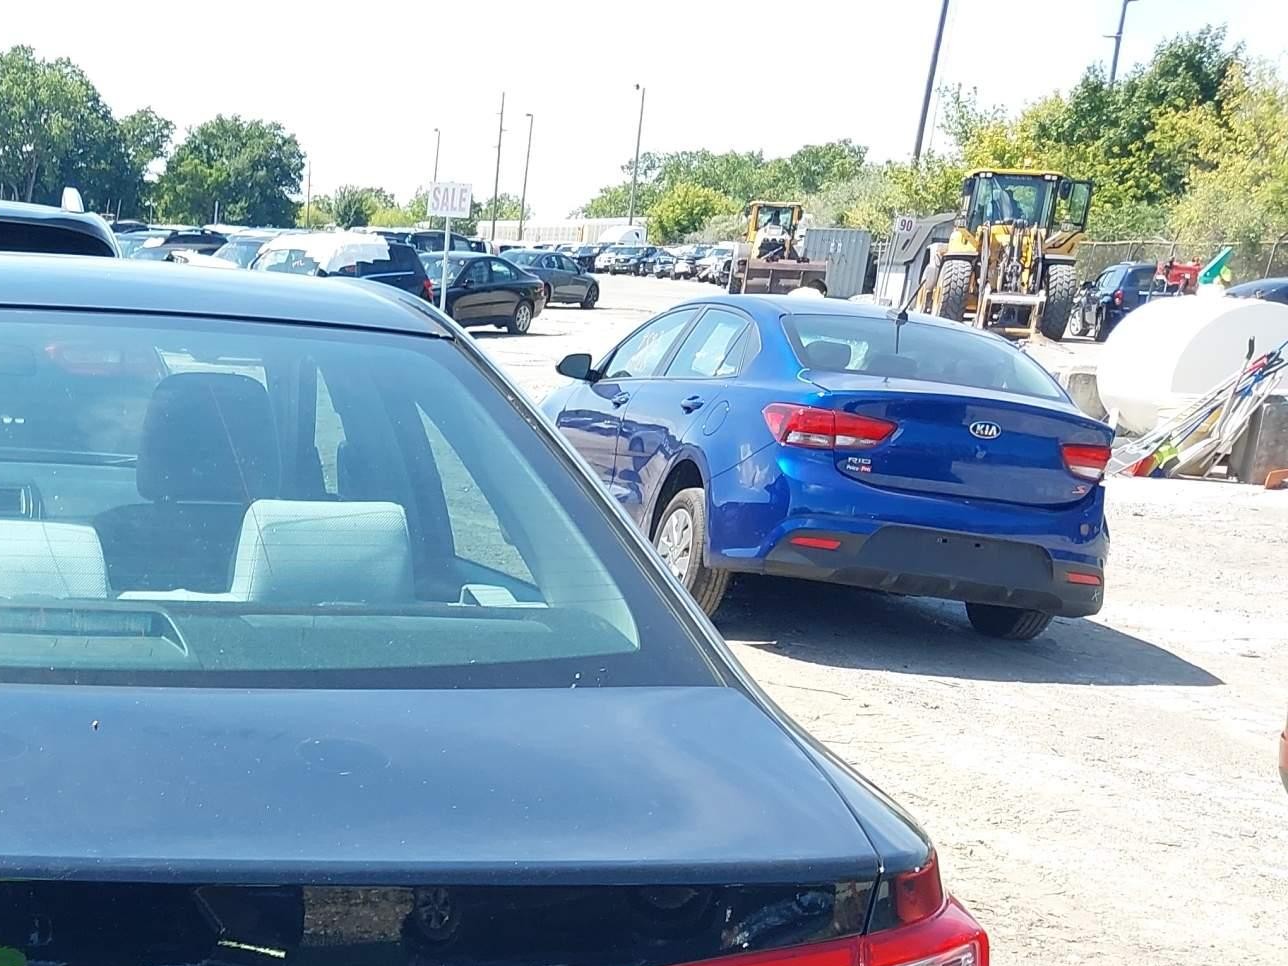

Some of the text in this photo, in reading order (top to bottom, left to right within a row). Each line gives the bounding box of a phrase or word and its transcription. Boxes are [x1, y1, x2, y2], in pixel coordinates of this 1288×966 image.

[432, 186, 468, 212] SALE
[900, 219, 913, 231] 90
[975, 423, 998, 436] KIA
[847, 457, 872, 465] RIO
